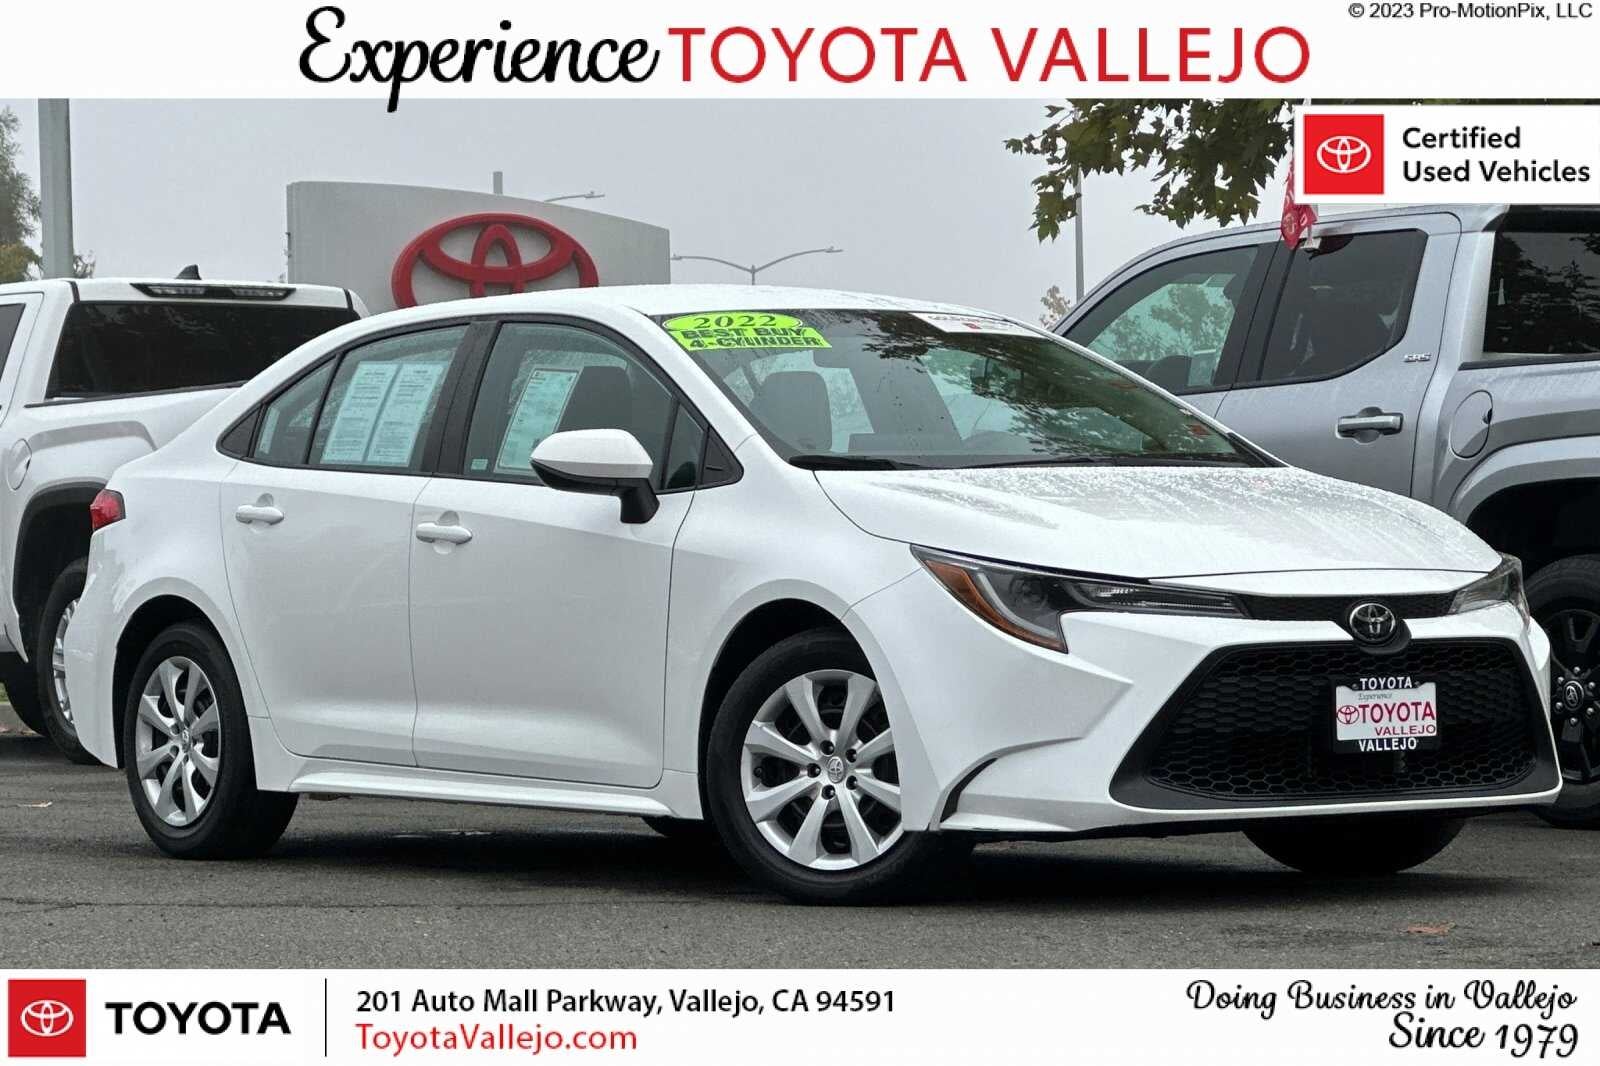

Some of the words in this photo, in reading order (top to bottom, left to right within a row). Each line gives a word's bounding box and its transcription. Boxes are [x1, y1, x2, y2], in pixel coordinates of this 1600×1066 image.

[693, 315, 777, 329] 2022
[682, 329, 743, 340] BEST
[755, 327, 807, 338] BUY
[690, 336, 821, 348] 4-CYLINDER
[1360, 676, 1413, 690] TOYOTA
[1358, 701, 1436, 724] TOYOTA
[1375, 724, 1437, 736] VALLEJO
[1359, 737, 1417, 752] VALLEJO
